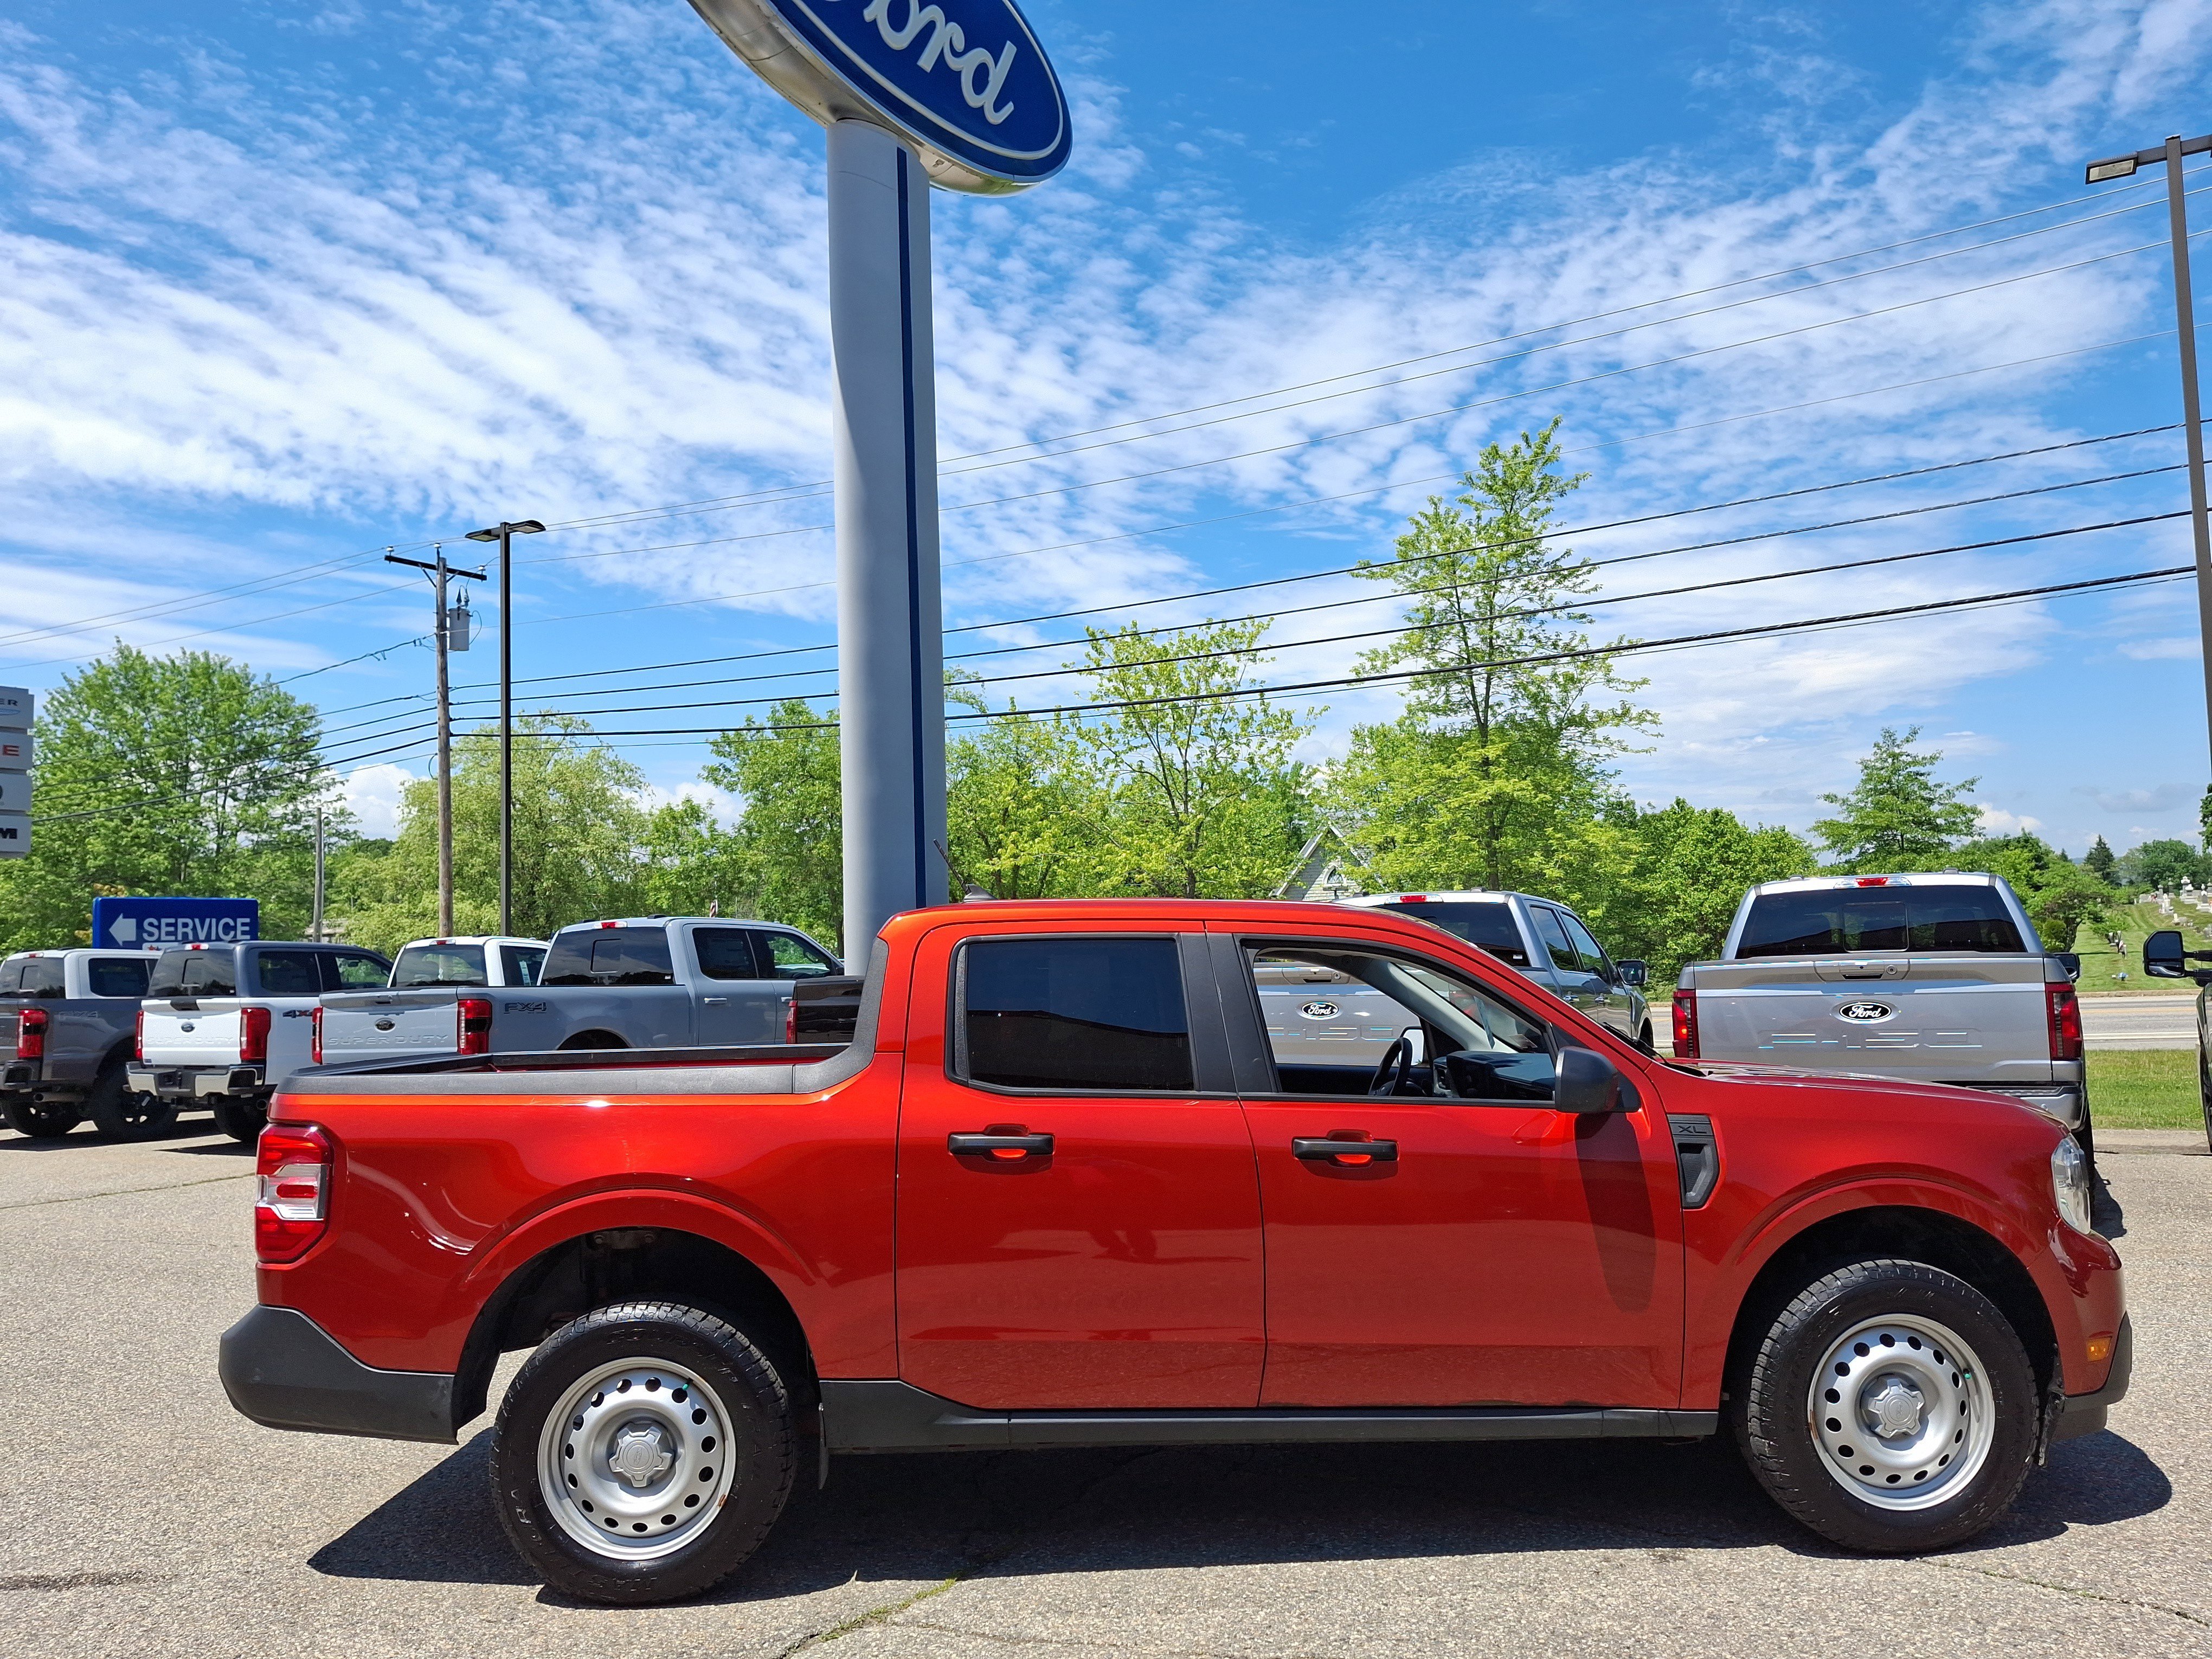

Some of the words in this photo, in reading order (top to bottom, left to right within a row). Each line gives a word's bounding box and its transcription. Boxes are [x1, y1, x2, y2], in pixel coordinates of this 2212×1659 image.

[825, 0, 1017, 125] ord
[142, 917, 250, 941] SERVICE
[504, 1001, 547, 1014] FX4
[1308, 1004, 1332, 1015] Ford
[1849, 1004, 1881, 1018] Ford
[329, 1036, 390, 1045] SUPER
[395, 1035, 448, 1044] DUTY
[1678, 1125, 1707, 1134] XL
